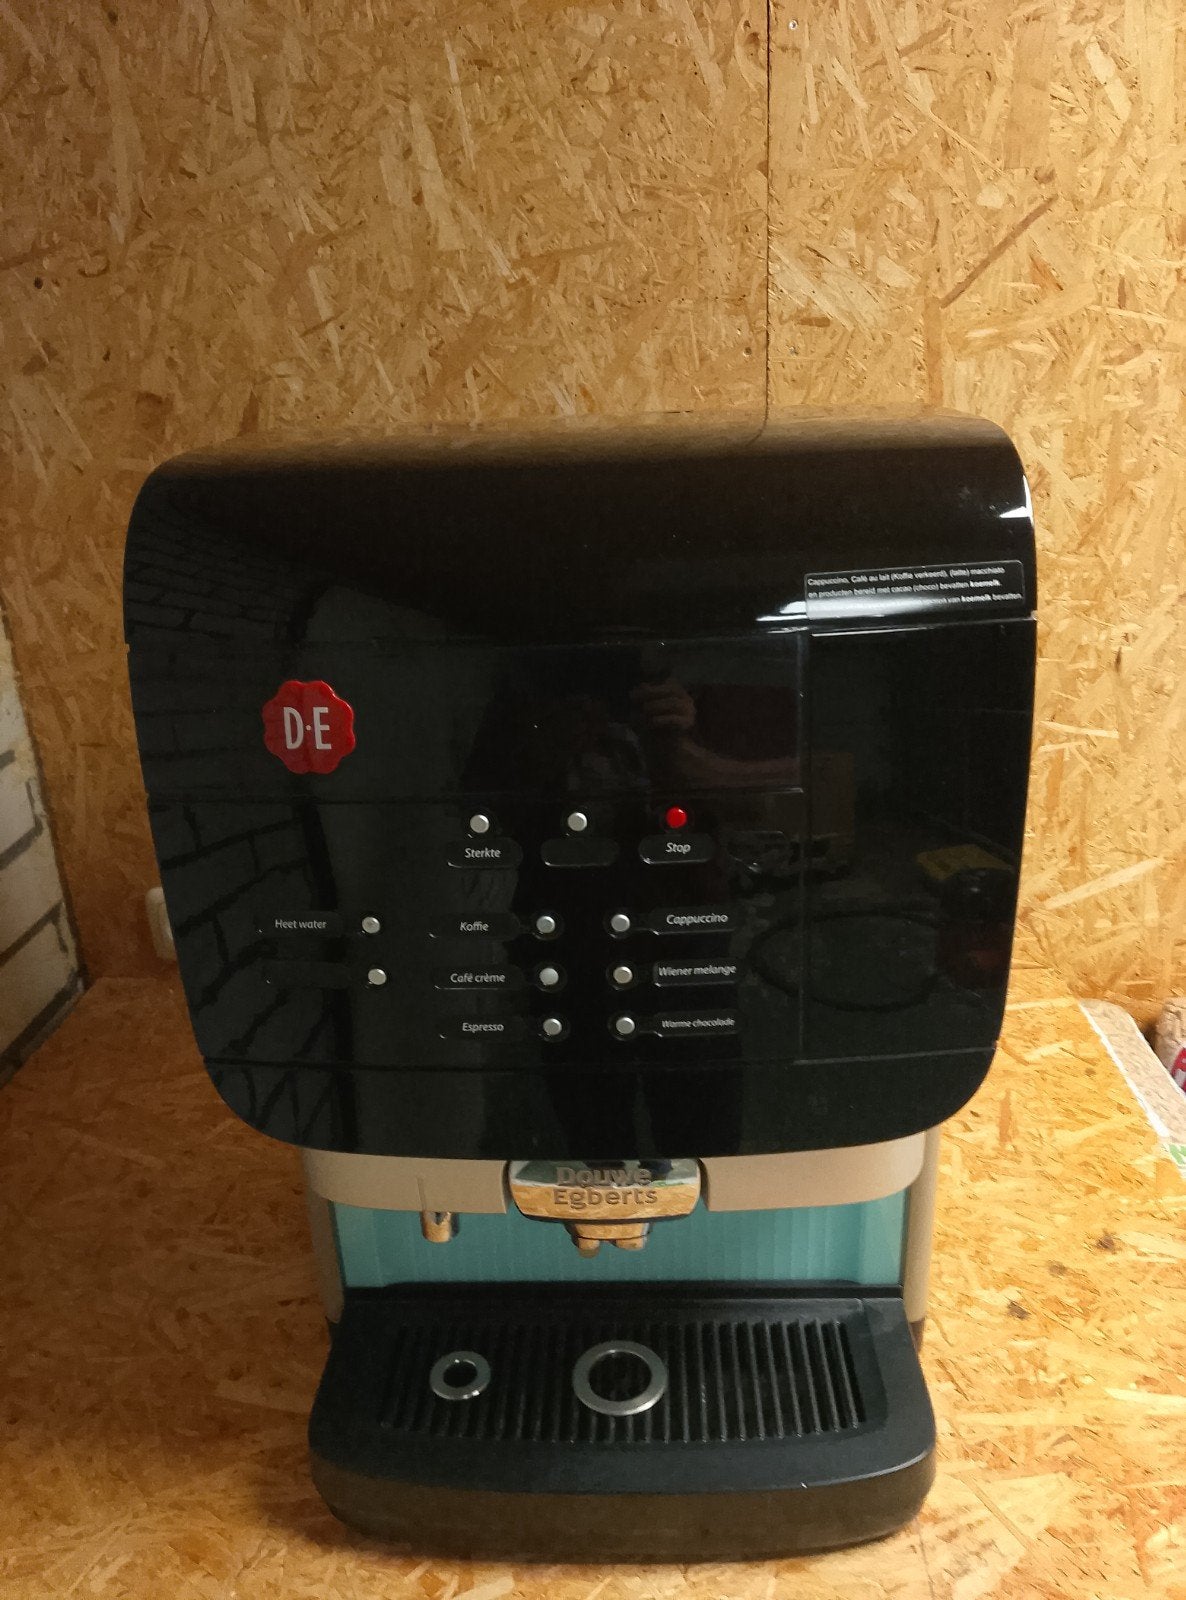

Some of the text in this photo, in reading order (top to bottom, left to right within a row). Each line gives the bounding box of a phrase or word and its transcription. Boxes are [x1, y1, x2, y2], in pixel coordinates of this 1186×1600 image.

[464, 847, 501, 859] Sterkte
[666, 842, 691, 854] Stop
[274, 919, 327, 929] Heet water
[666, 913, 729, 926] Cappuccino
[460, 921, 490, 931] Koffie
[659, 965, 737, 976] Wiener melange
[450, 972, 506, 983] Café crème
[462, 1022, 505, 1034] Espresso
[662, 1018, 735, 1028] Warme chocolade
[556, 1166, 651, 1188] Douwe
[553, 1188, 659, 1210] Egberts
